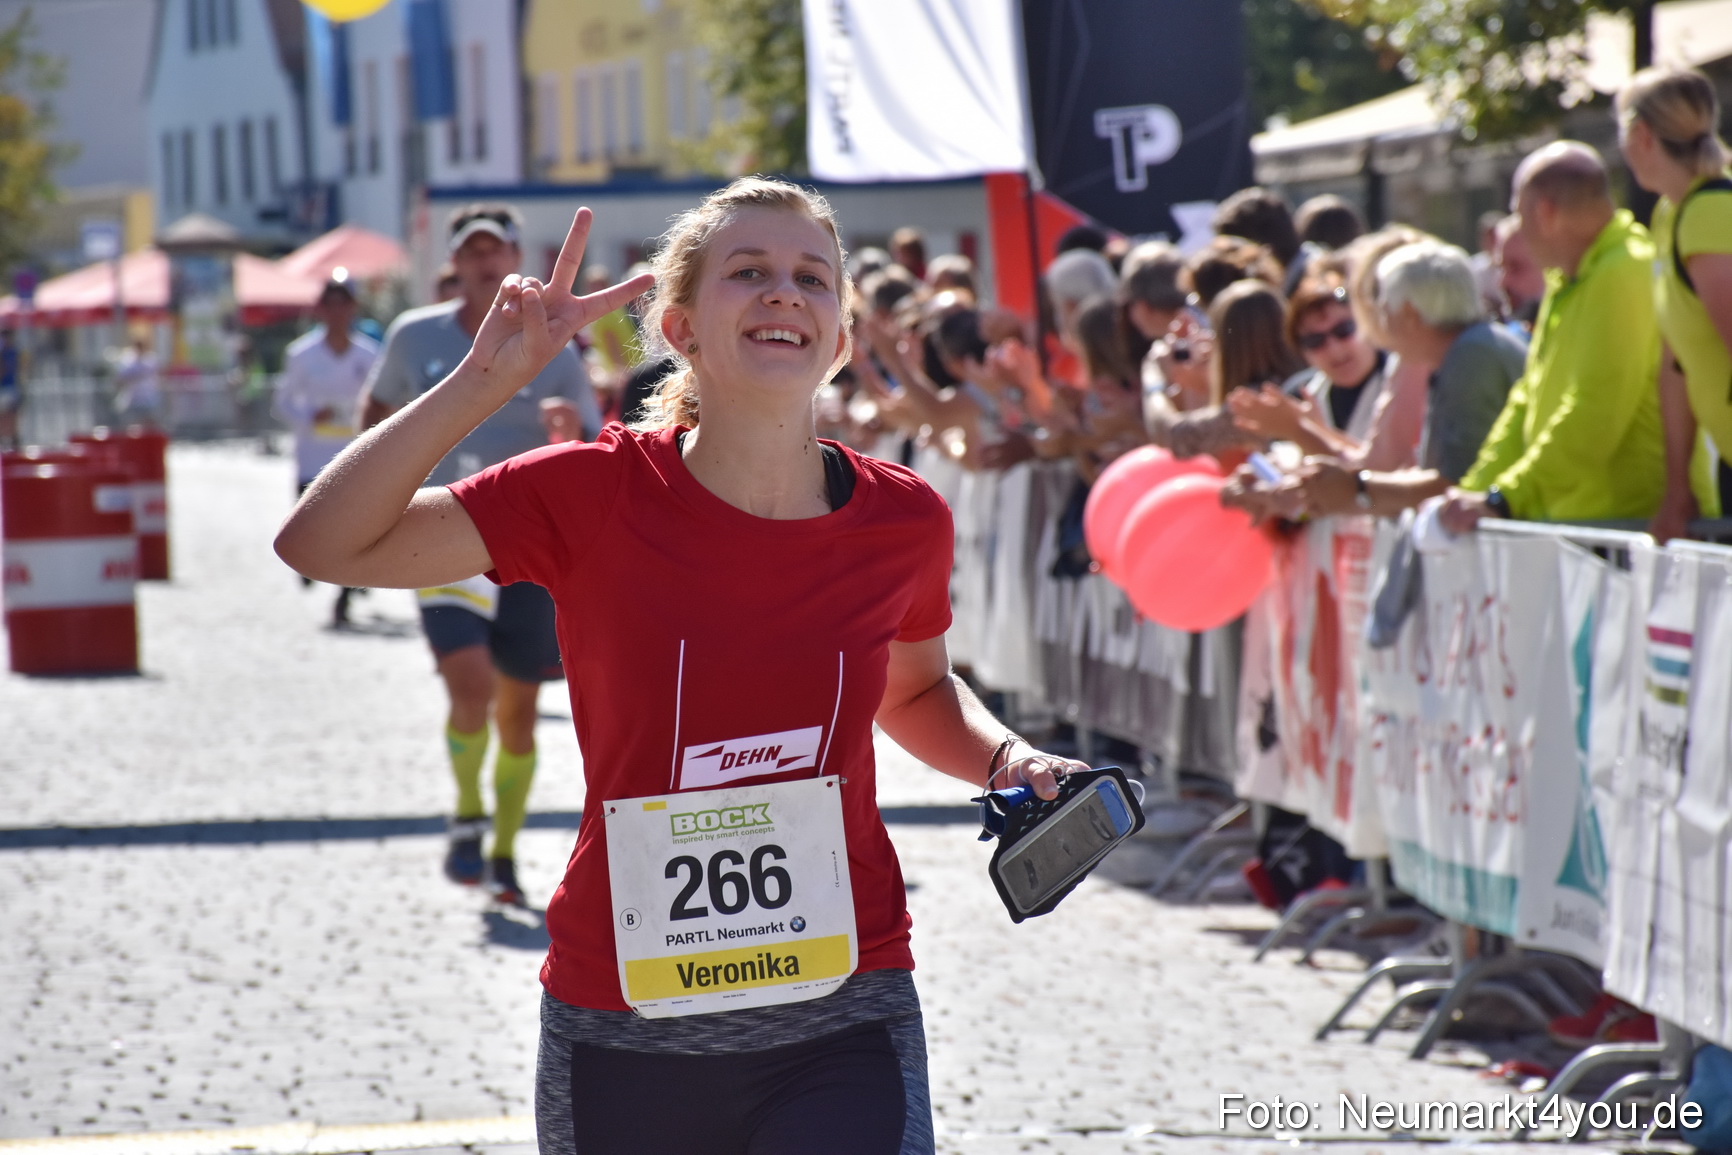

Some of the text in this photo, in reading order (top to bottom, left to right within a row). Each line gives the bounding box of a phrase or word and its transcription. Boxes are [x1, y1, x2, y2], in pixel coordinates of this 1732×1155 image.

[719, 745, 783, 771] DEHN
[670, 803, 773, 836] BOCK
[672, 834, 703, 844] inspired
[717, 831, 739, 839] smart
[741, 826, 775, 836] concepts
[664, 844, 792, 921] 266
[626, 913, 635, 926] B
[666, 921, 785, 946] PARTL Neumarkt
[676, 952, 800, 989] Veronika
